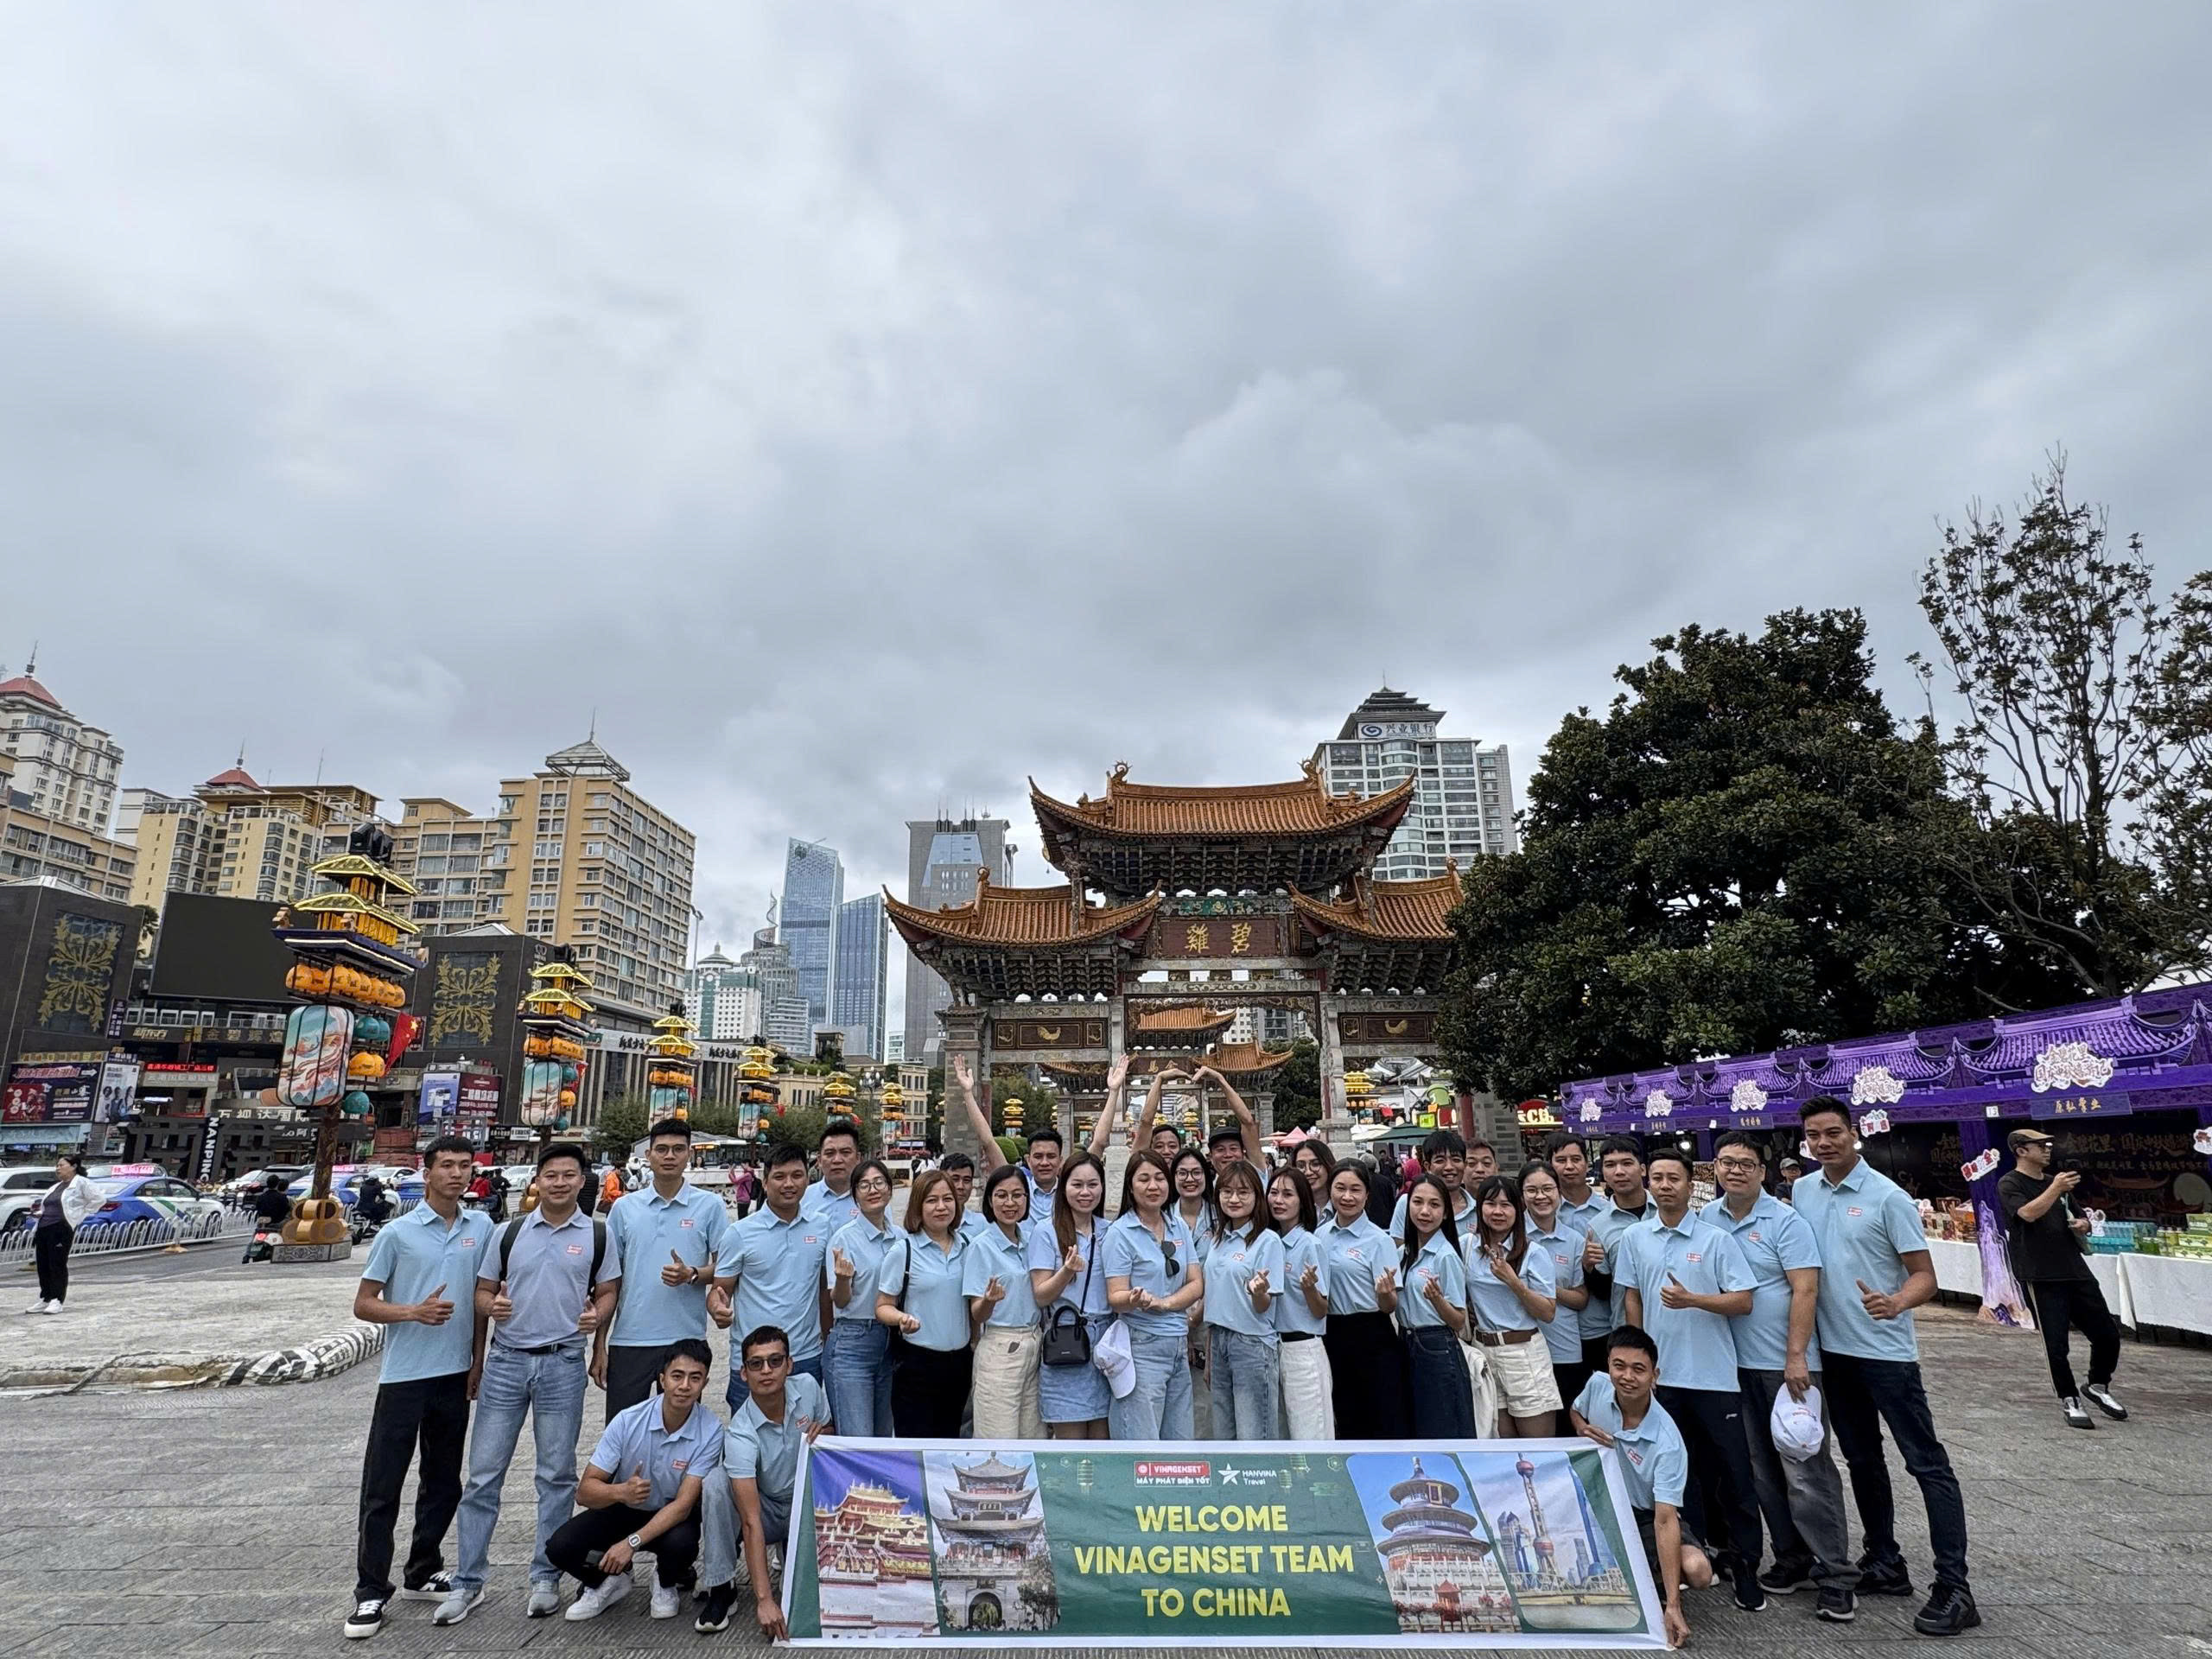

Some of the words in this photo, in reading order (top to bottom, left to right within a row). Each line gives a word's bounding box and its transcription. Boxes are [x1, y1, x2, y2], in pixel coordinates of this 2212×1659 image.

[1386, 723, 1433, 734] 兴业银行
[1136, 1476, 1154, 1484] MÁY
[1156, 1476, 1176, 1484] PHÁT
[1135, 1505, 1288, 1532] WELCOME
[1074, 1545, 1263, 1574] VINAGENSET
[1269, 1544, 1354, 1573] TEAM
[1141, 1588, 1185, 1617] TO
[1192, 1587, 1292, 1617] CHINA
